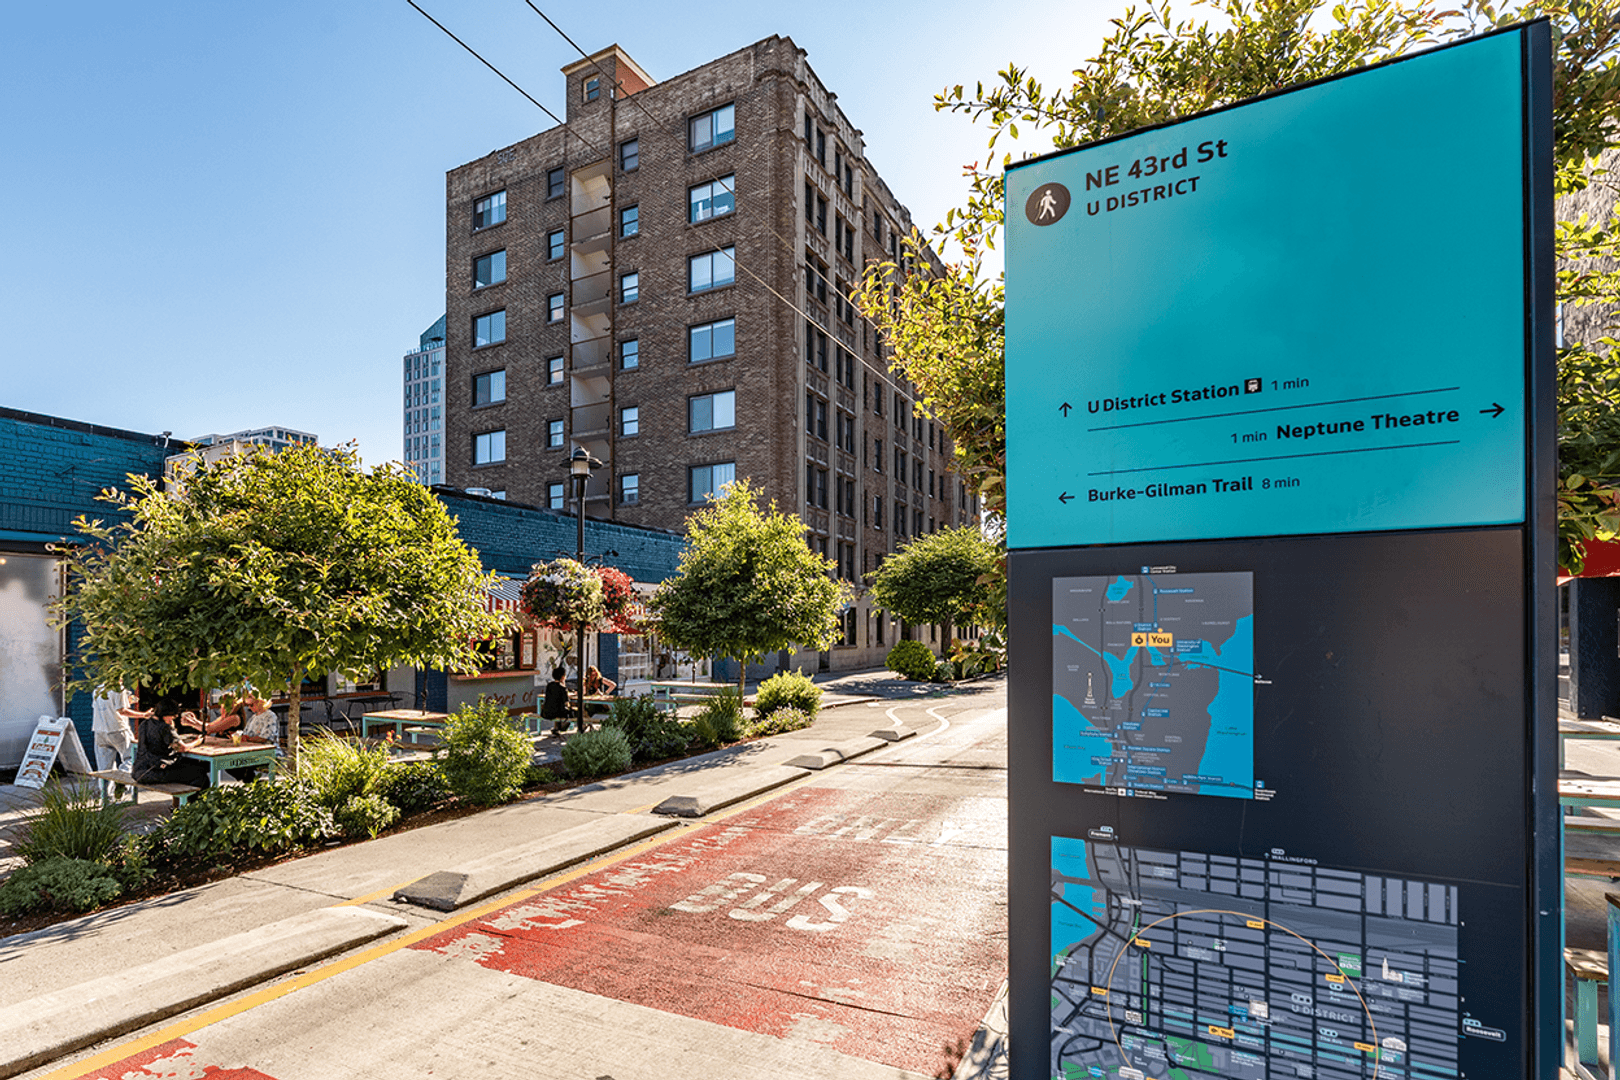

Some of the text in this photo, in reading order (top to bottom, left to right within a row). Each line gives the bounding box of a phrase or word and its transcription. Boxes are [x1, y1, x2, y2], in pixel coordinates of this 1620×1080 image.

[1086, 138, 1229, 191] NE 43rd St
[1087, 175, 1201, 216] U DISTRICT
[1088, 377, 1310, 414] U District Station 1 min
[1231, 410, 1460, 444] 1 min Neptune Theatre
[1088, 476, 1301, 502] Burke-Gilman Trail 8 min
[1151, 635, 1170, 644] You
[669, 872, 873, 932] BUS
[1291, 1004, 1356, 1023] U DISTRICT
